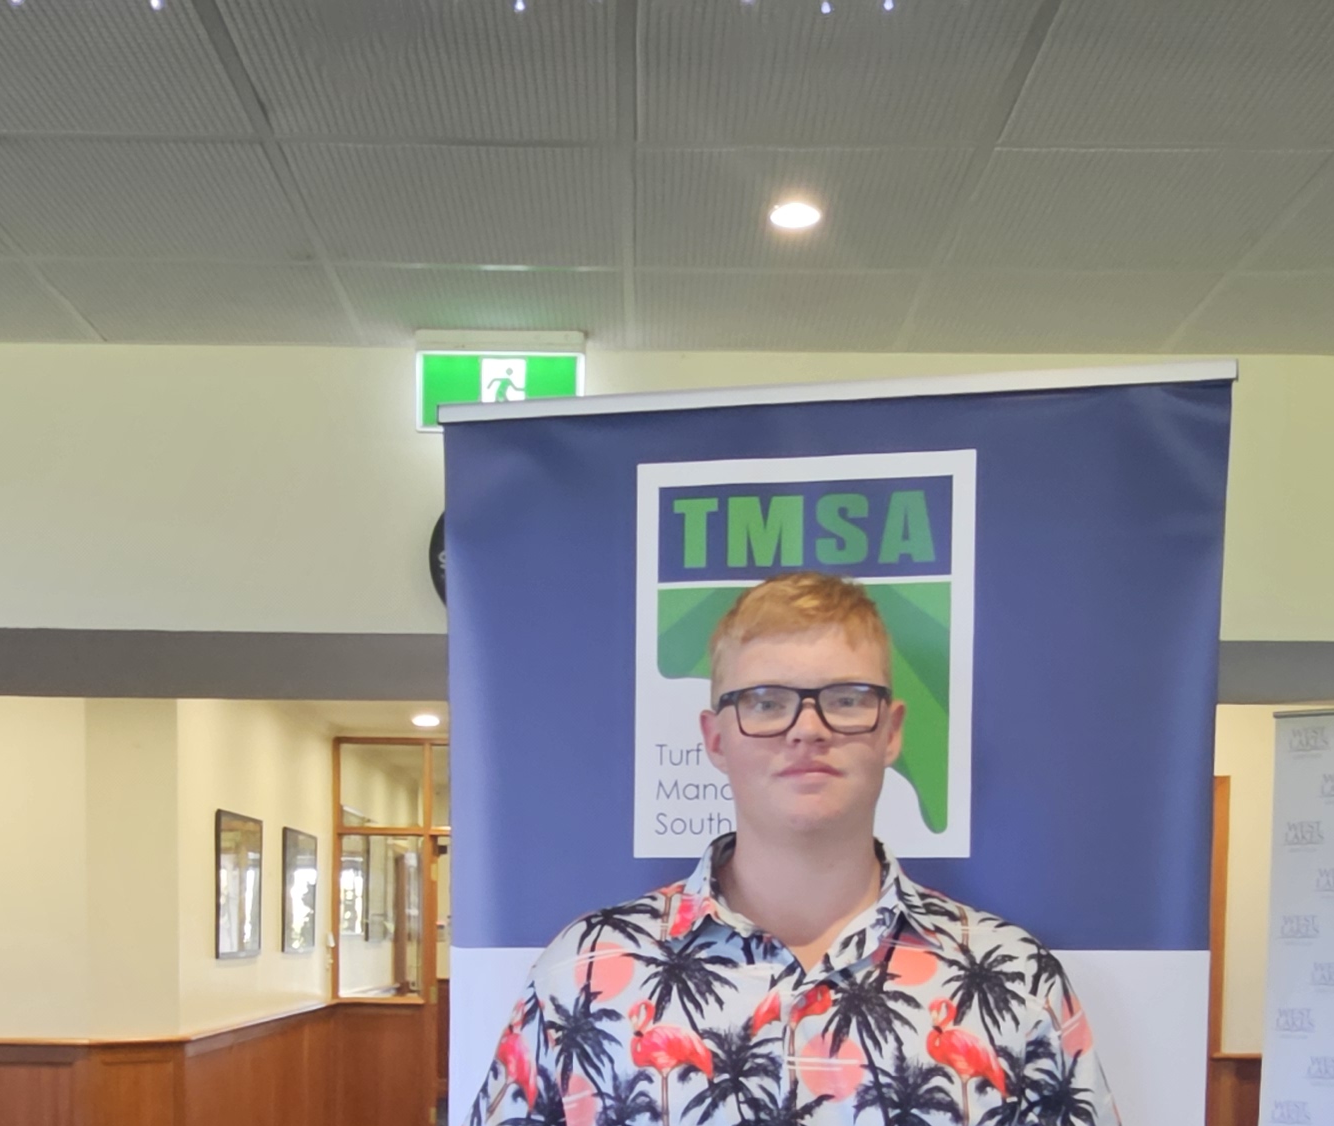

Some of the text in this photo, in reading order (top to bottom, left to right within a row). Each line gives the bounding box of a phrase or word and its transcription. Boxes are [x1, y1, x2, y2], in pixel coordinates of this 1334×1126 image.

[673, 490, 936, 568] TMSA
[655, 742, 703, 767] Turf
[655, 812, 732, 835] South
